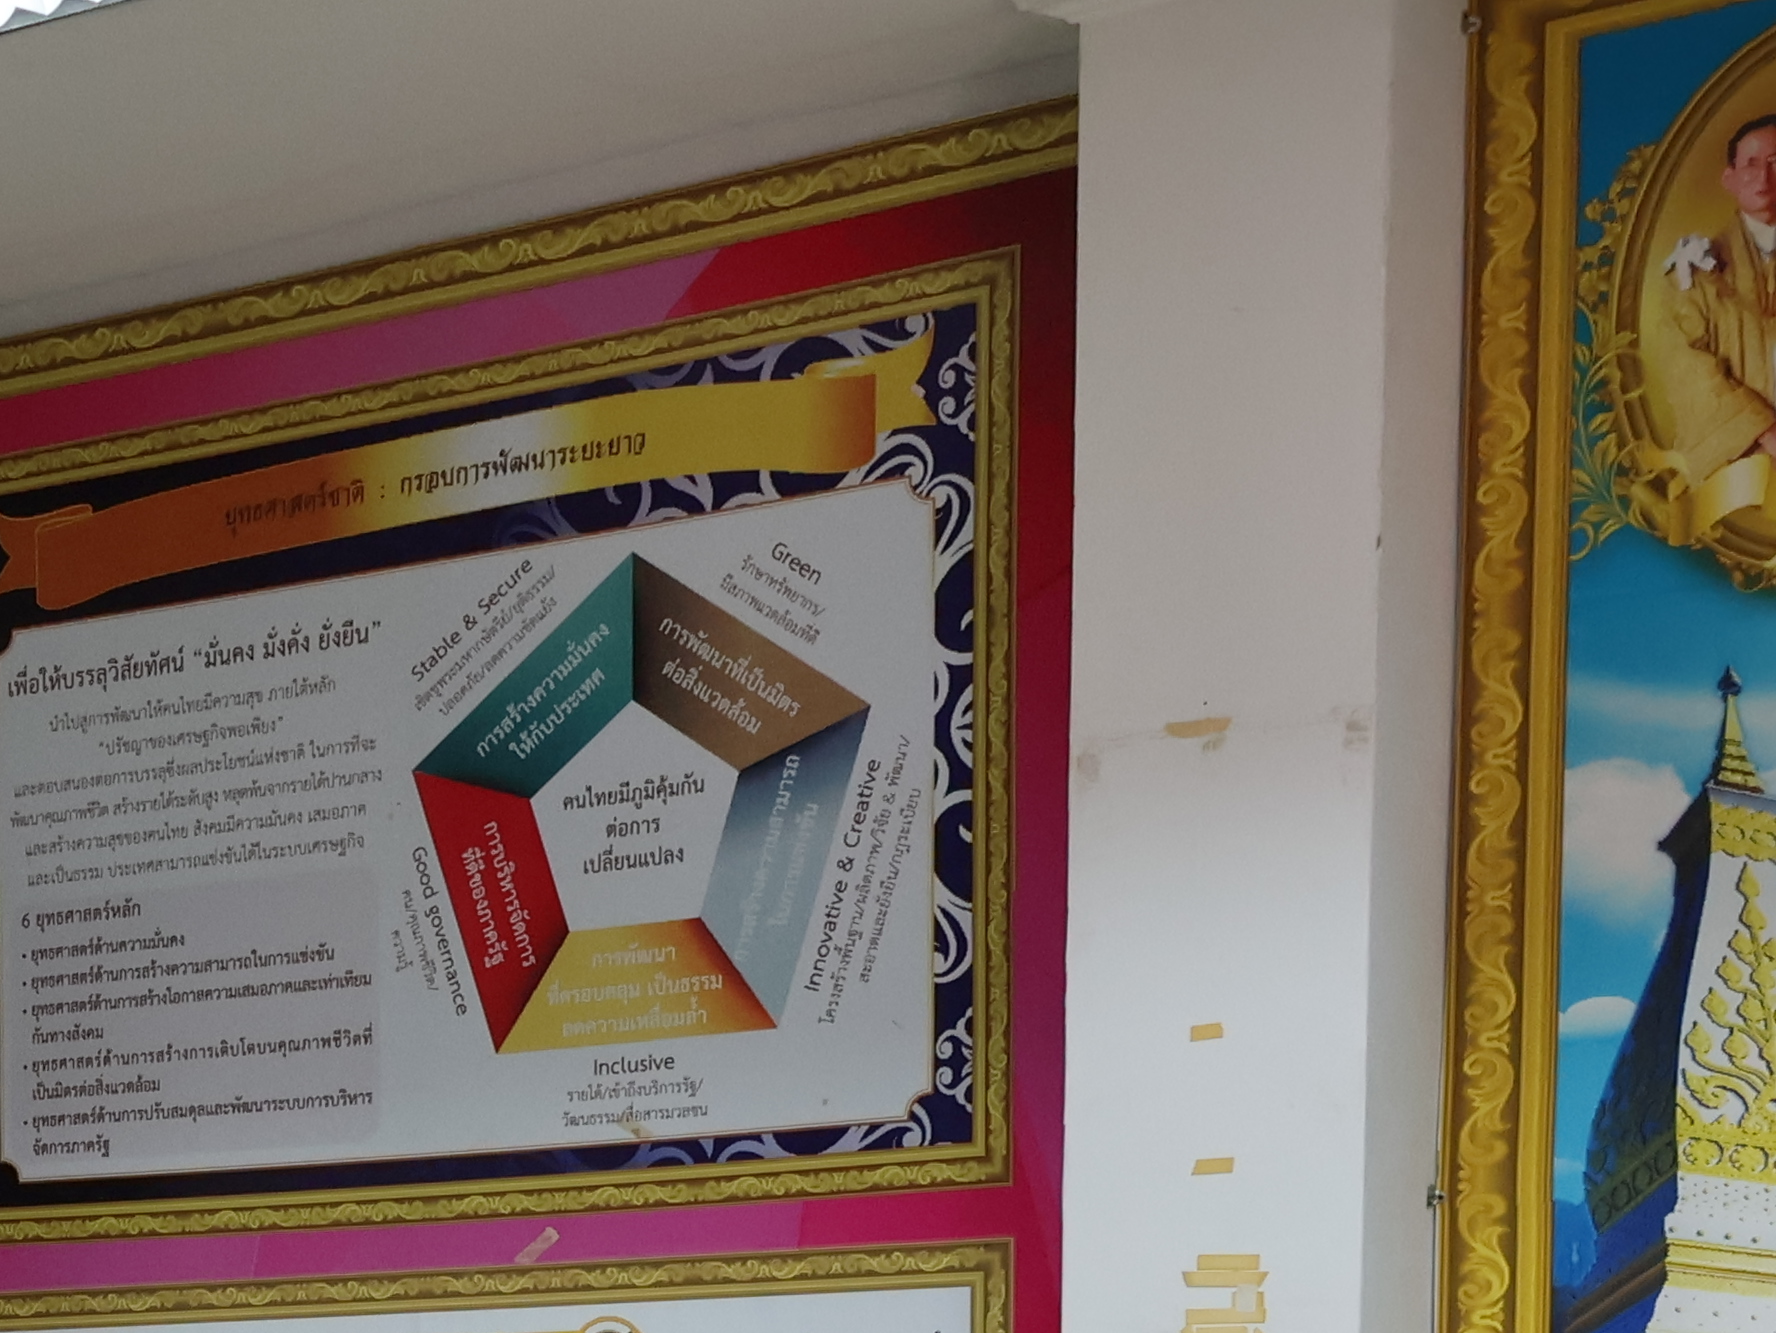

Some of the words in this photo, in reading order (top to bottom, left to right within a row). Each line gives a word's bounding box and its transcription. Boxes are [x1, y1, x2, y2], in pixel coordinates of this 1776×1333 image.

[770, 541, 823, 586] Green
[411, 629, 463, 683] Stable
[476, 558, 534, 616] Secure
[605, 815, 661, 840] ต่อการ
[411, 846, 439, 901] Good
[583, 845, 685, 876] เปลี่ยนแปลง
[803, 878, 848, 993] Innovative
[842, 757, 882, 849] Creative
[423, 903, 469, 1018] governance
[592, 1054, 676, 1077] Inclusive
